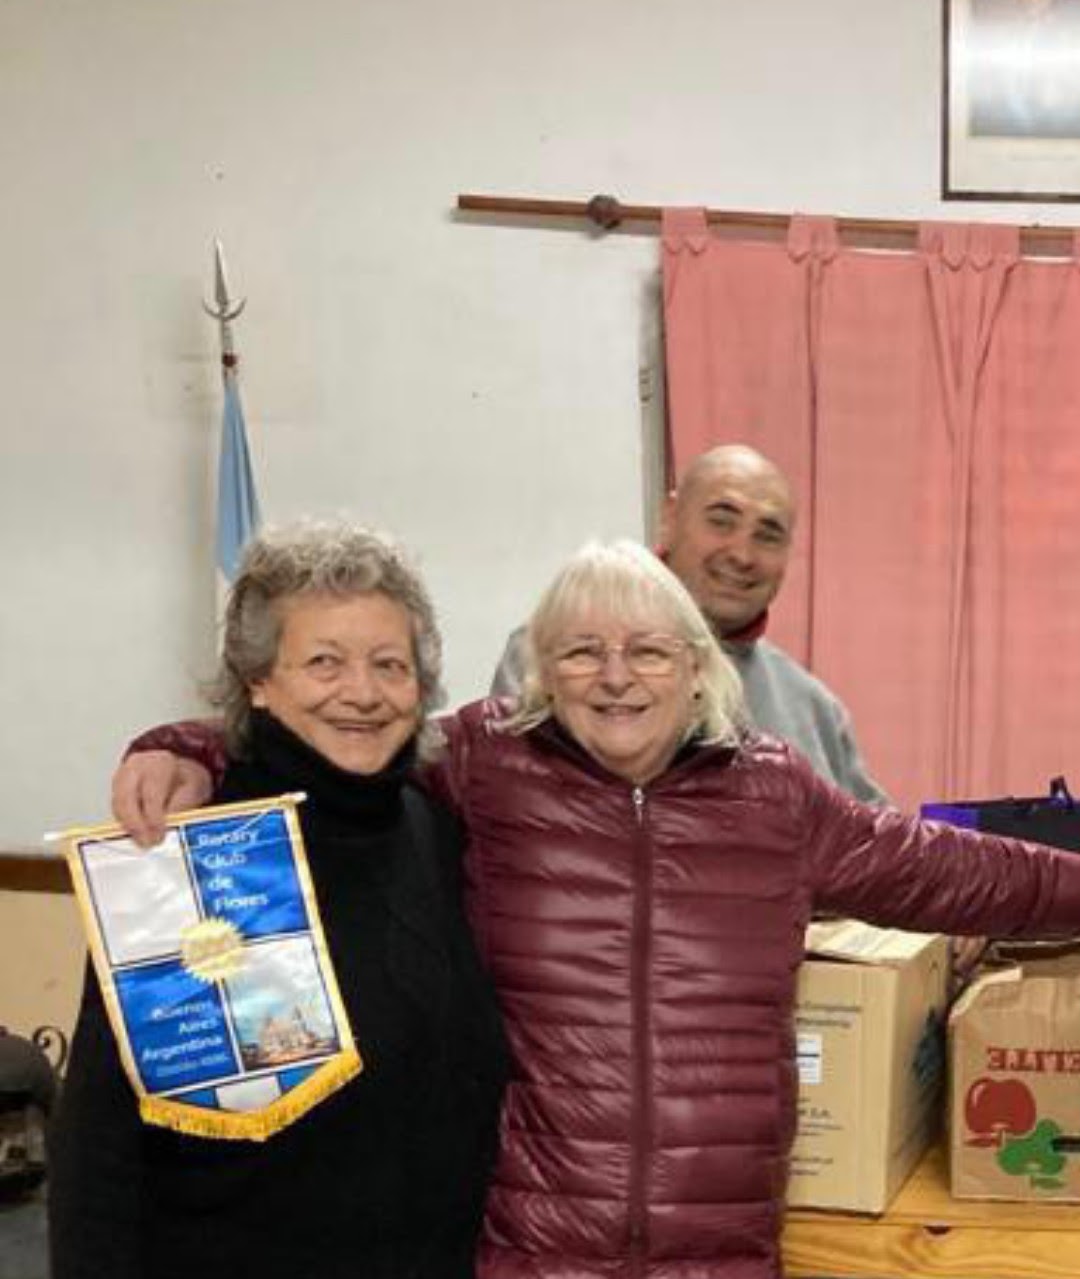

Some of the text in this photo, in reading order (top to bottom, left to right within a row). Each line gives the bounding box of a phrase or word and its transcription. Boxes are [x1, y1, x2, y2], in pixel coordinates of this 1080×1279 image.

[198, 825, 260, 848] Rotary
[202, 852, 247, 870] Club
[208, 875, 234, 891] de
[215, 893, 269, 911] Flores
[179, 1017, 218, 1035] Aires
[142, 1034, 224, 1061] Argentina
